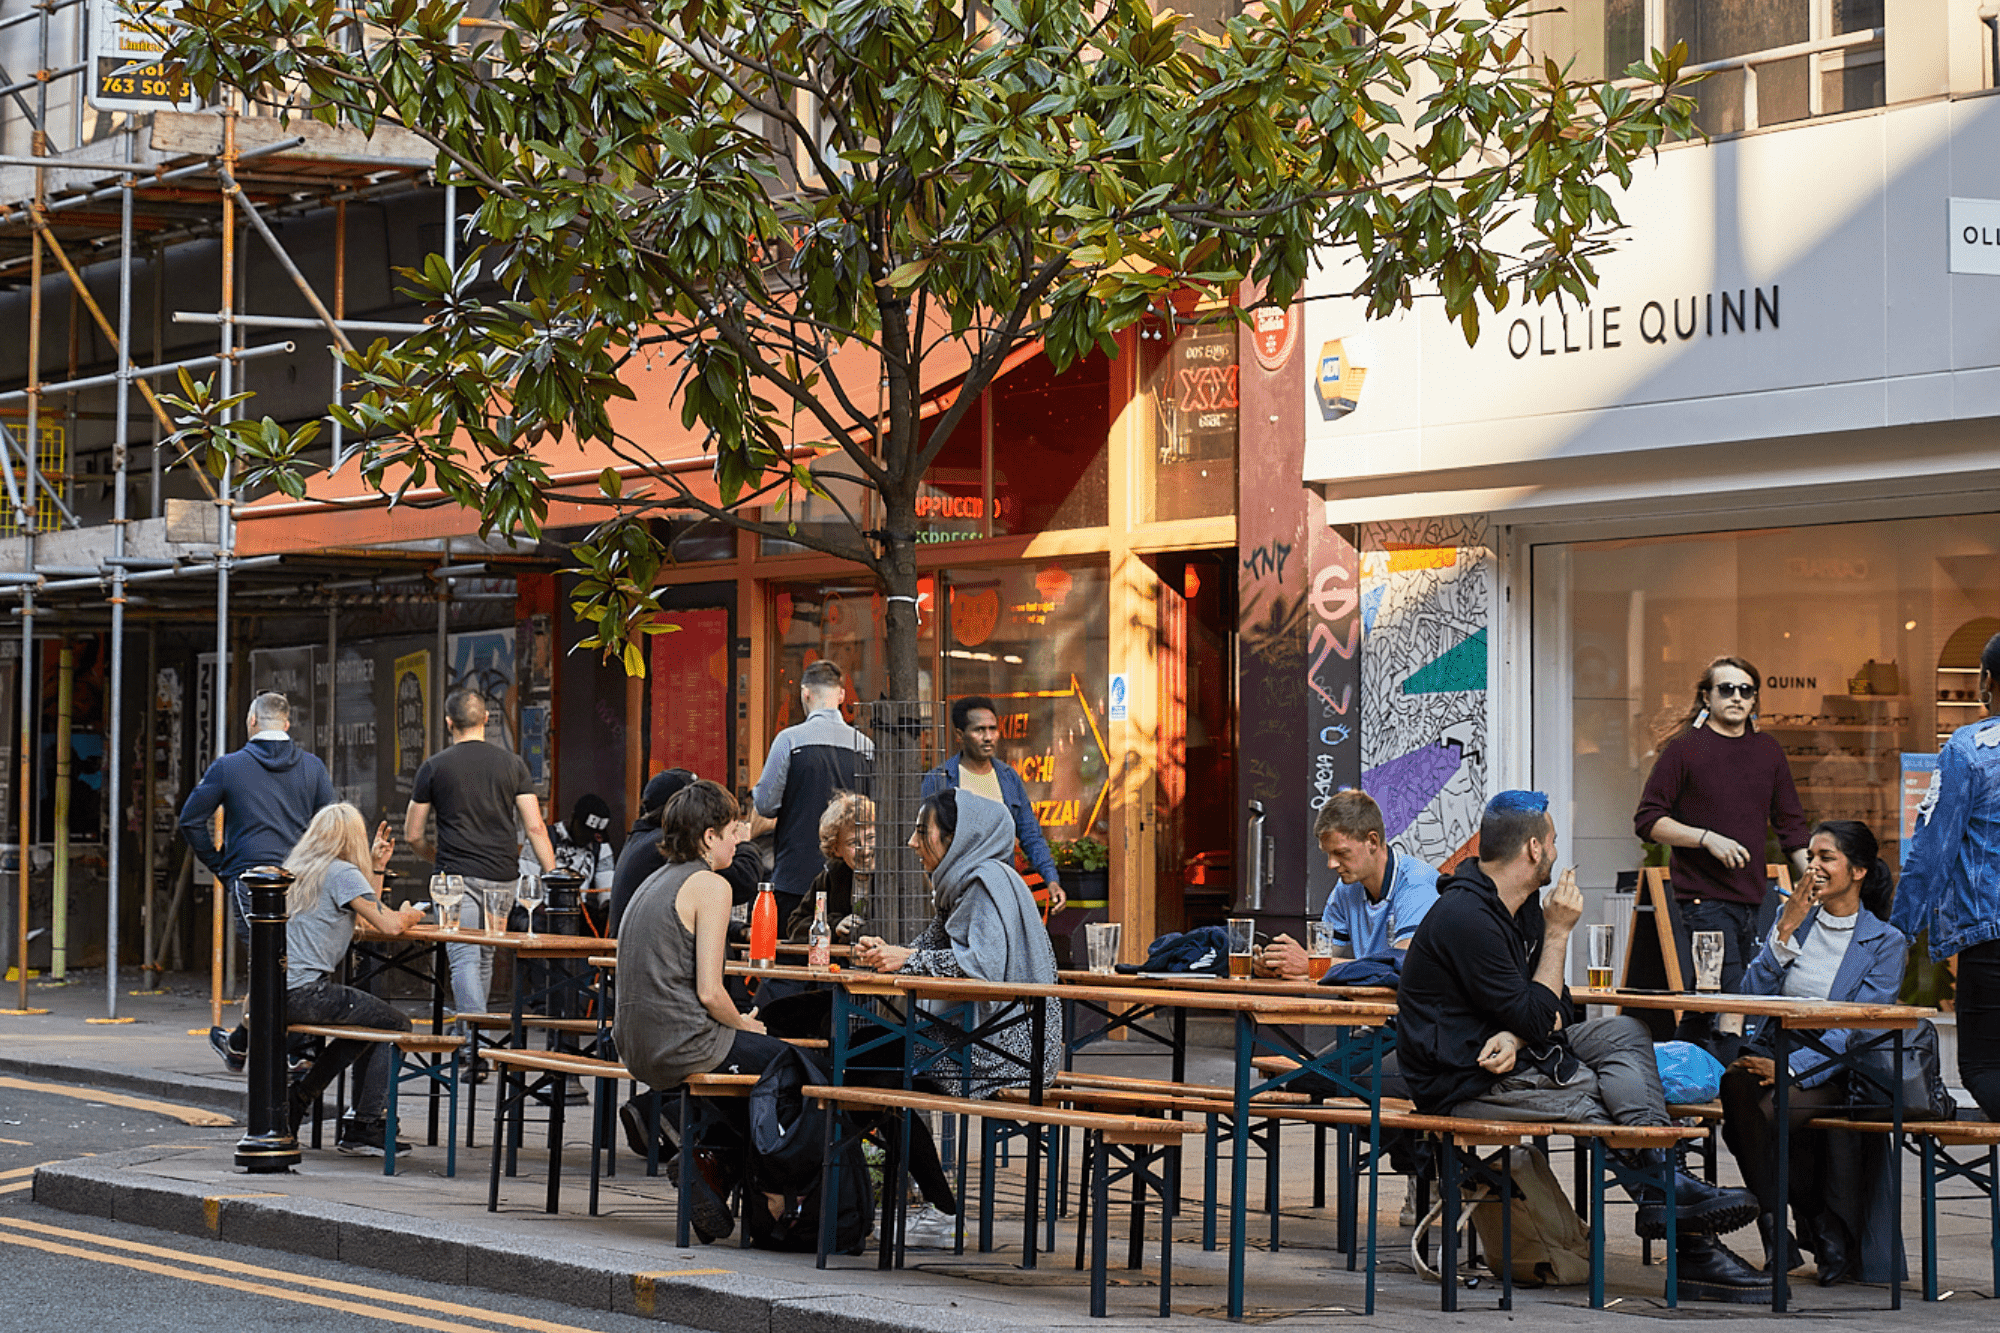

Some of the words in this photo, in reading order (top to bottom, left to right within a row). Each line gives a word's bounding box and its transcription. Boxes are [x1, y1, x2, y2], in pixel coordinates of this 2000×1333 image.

[102, 77, 134, 94] 763
[1508, 306, 1622, 360] OLLIE
[1640, 284, 1780, 346] QUINN
[1766, 675, 1817, 690] QUINN
[998, 713, 1029, 739] KIE!
[1008, 755, 1055, 783] NCH!
[1031, 800, 1081, 827] IZZA!
